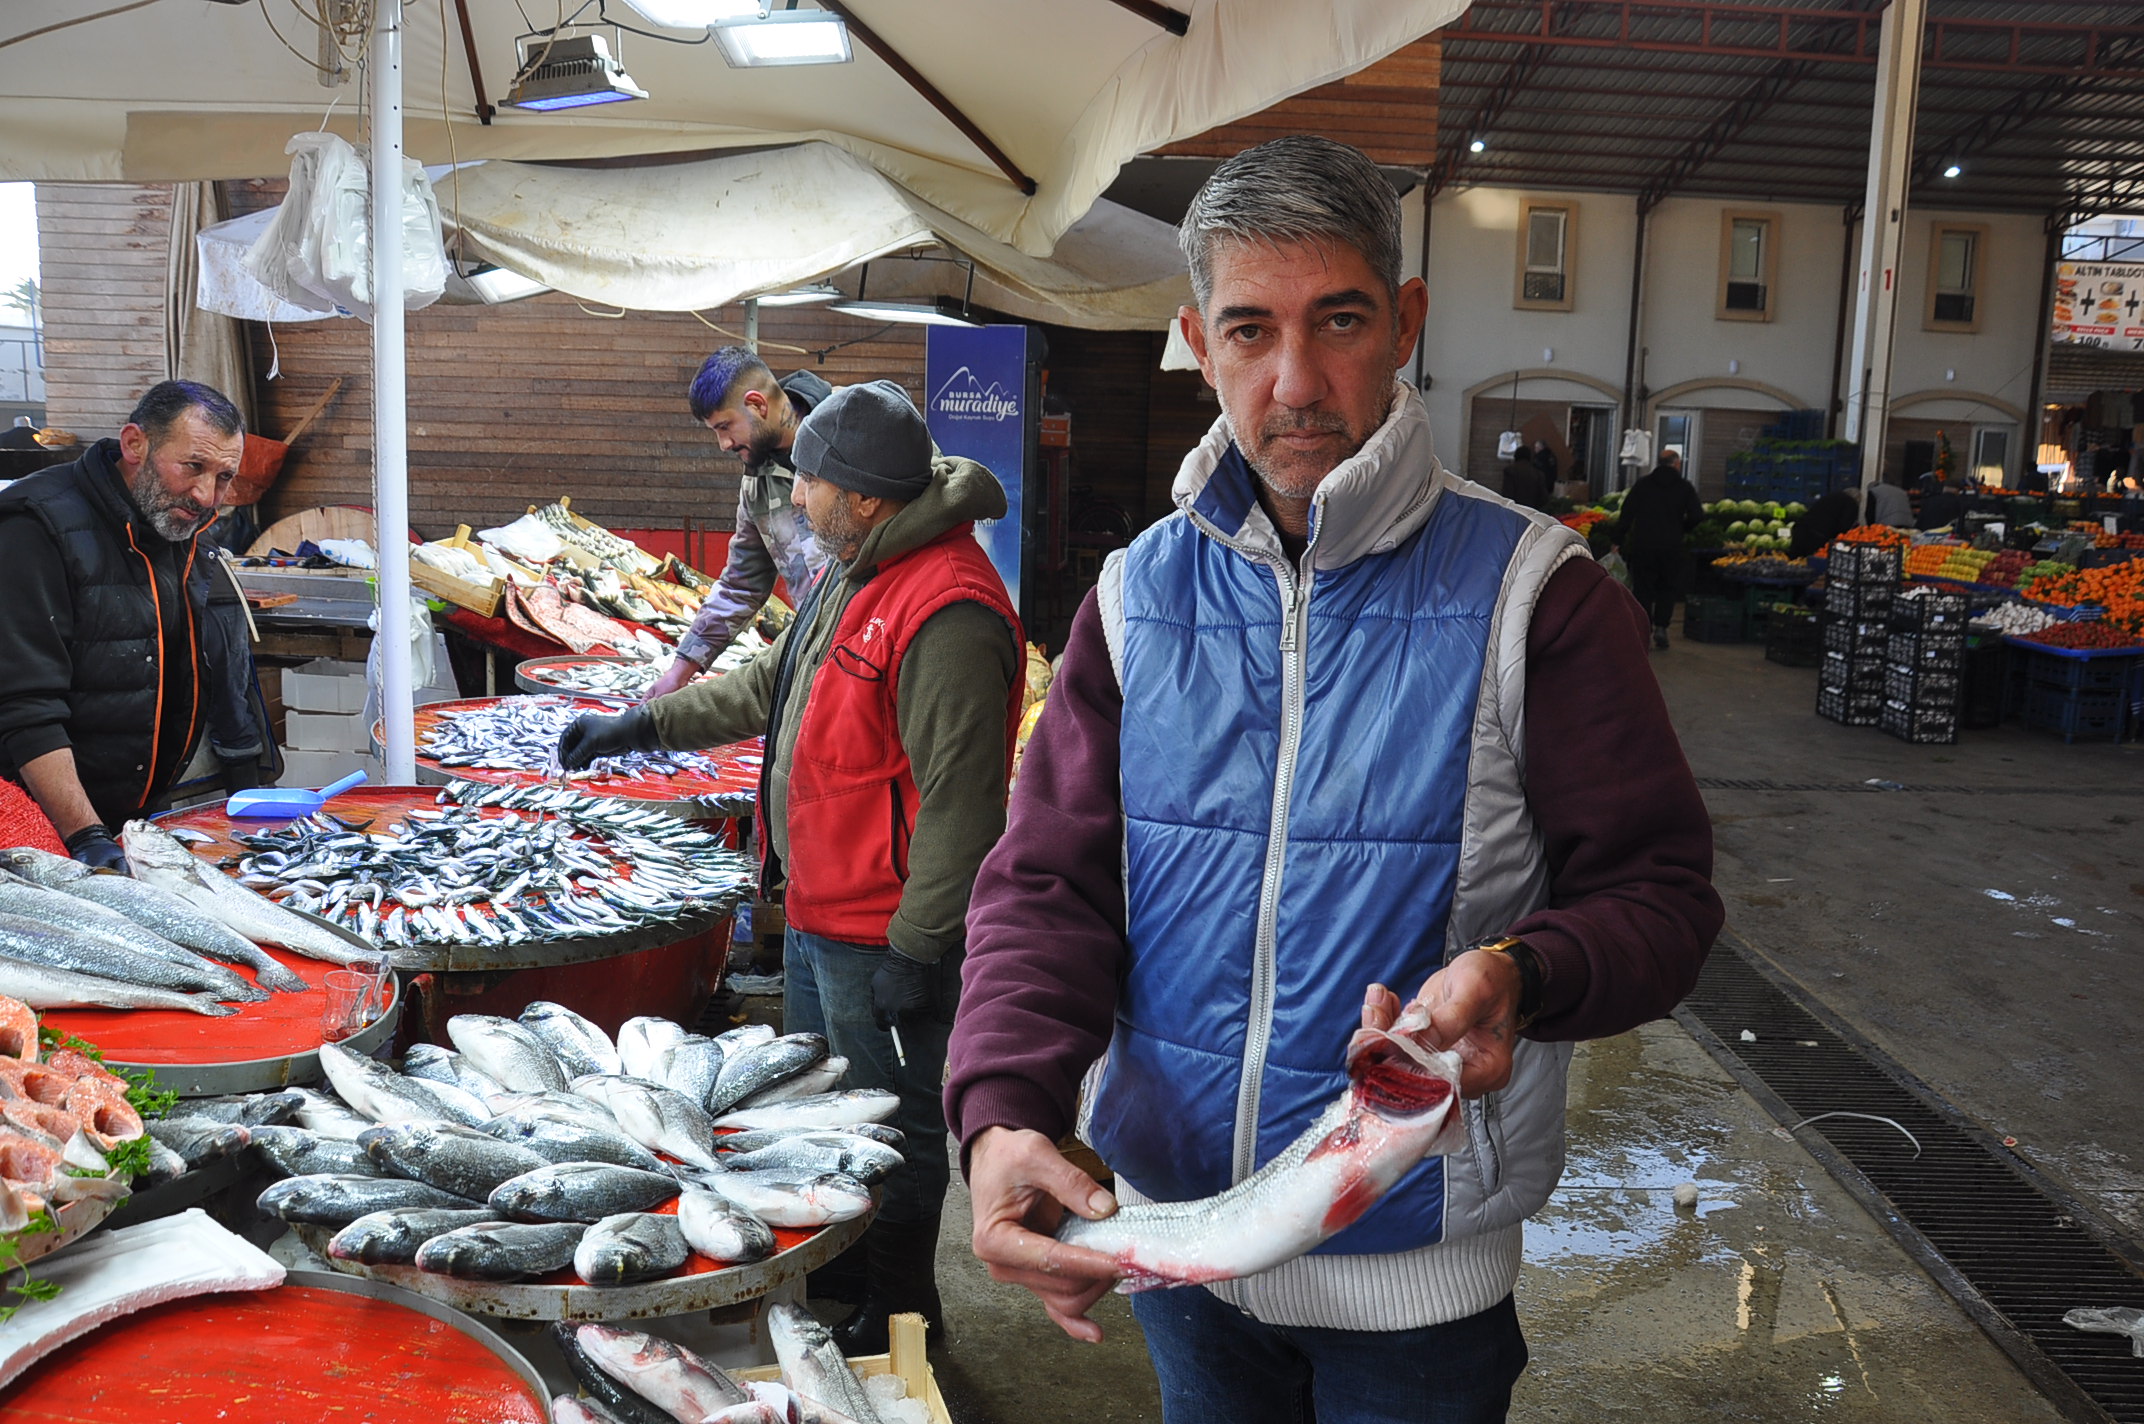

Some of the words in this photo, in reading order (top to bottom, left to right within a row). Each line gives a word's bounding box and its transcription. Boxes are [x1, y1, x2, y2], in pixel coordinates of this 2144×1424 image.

[1884, 269, 1892, 291] 1
[2079, 336, 2102, 347] 100
[2133, 338, 2144, 349] 7
[949, 391, 981, 399] BURSA
[940, 394, 1019, 421] muradiye
